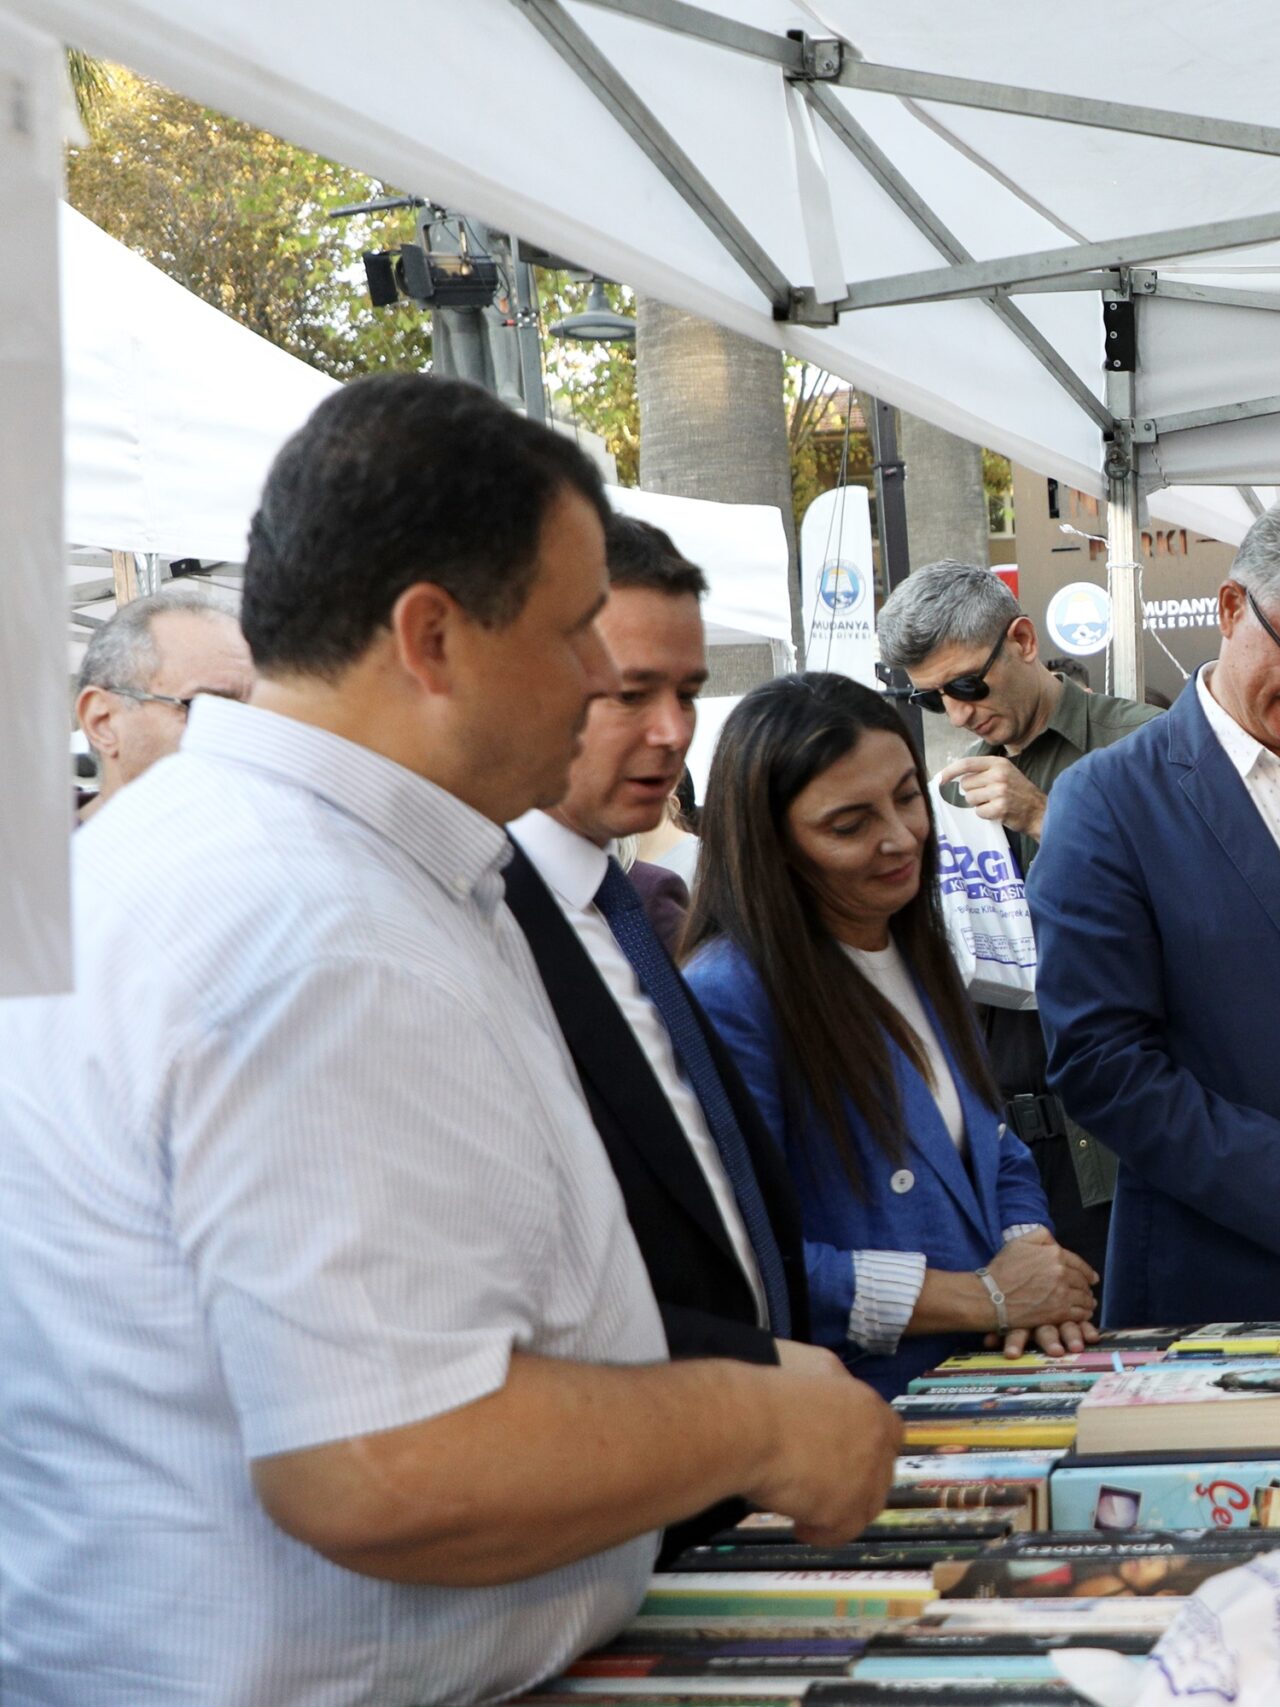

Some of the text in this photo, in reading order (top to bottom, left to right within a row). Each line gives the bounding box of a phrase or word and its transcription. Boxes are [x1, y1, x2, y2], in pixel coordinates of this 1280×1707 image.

[1142, 597, 1219, 616] MUDANY
[812, 620, 870, 630] MUDANYA
[1116, 1543, 1175, 1554] VEDA
